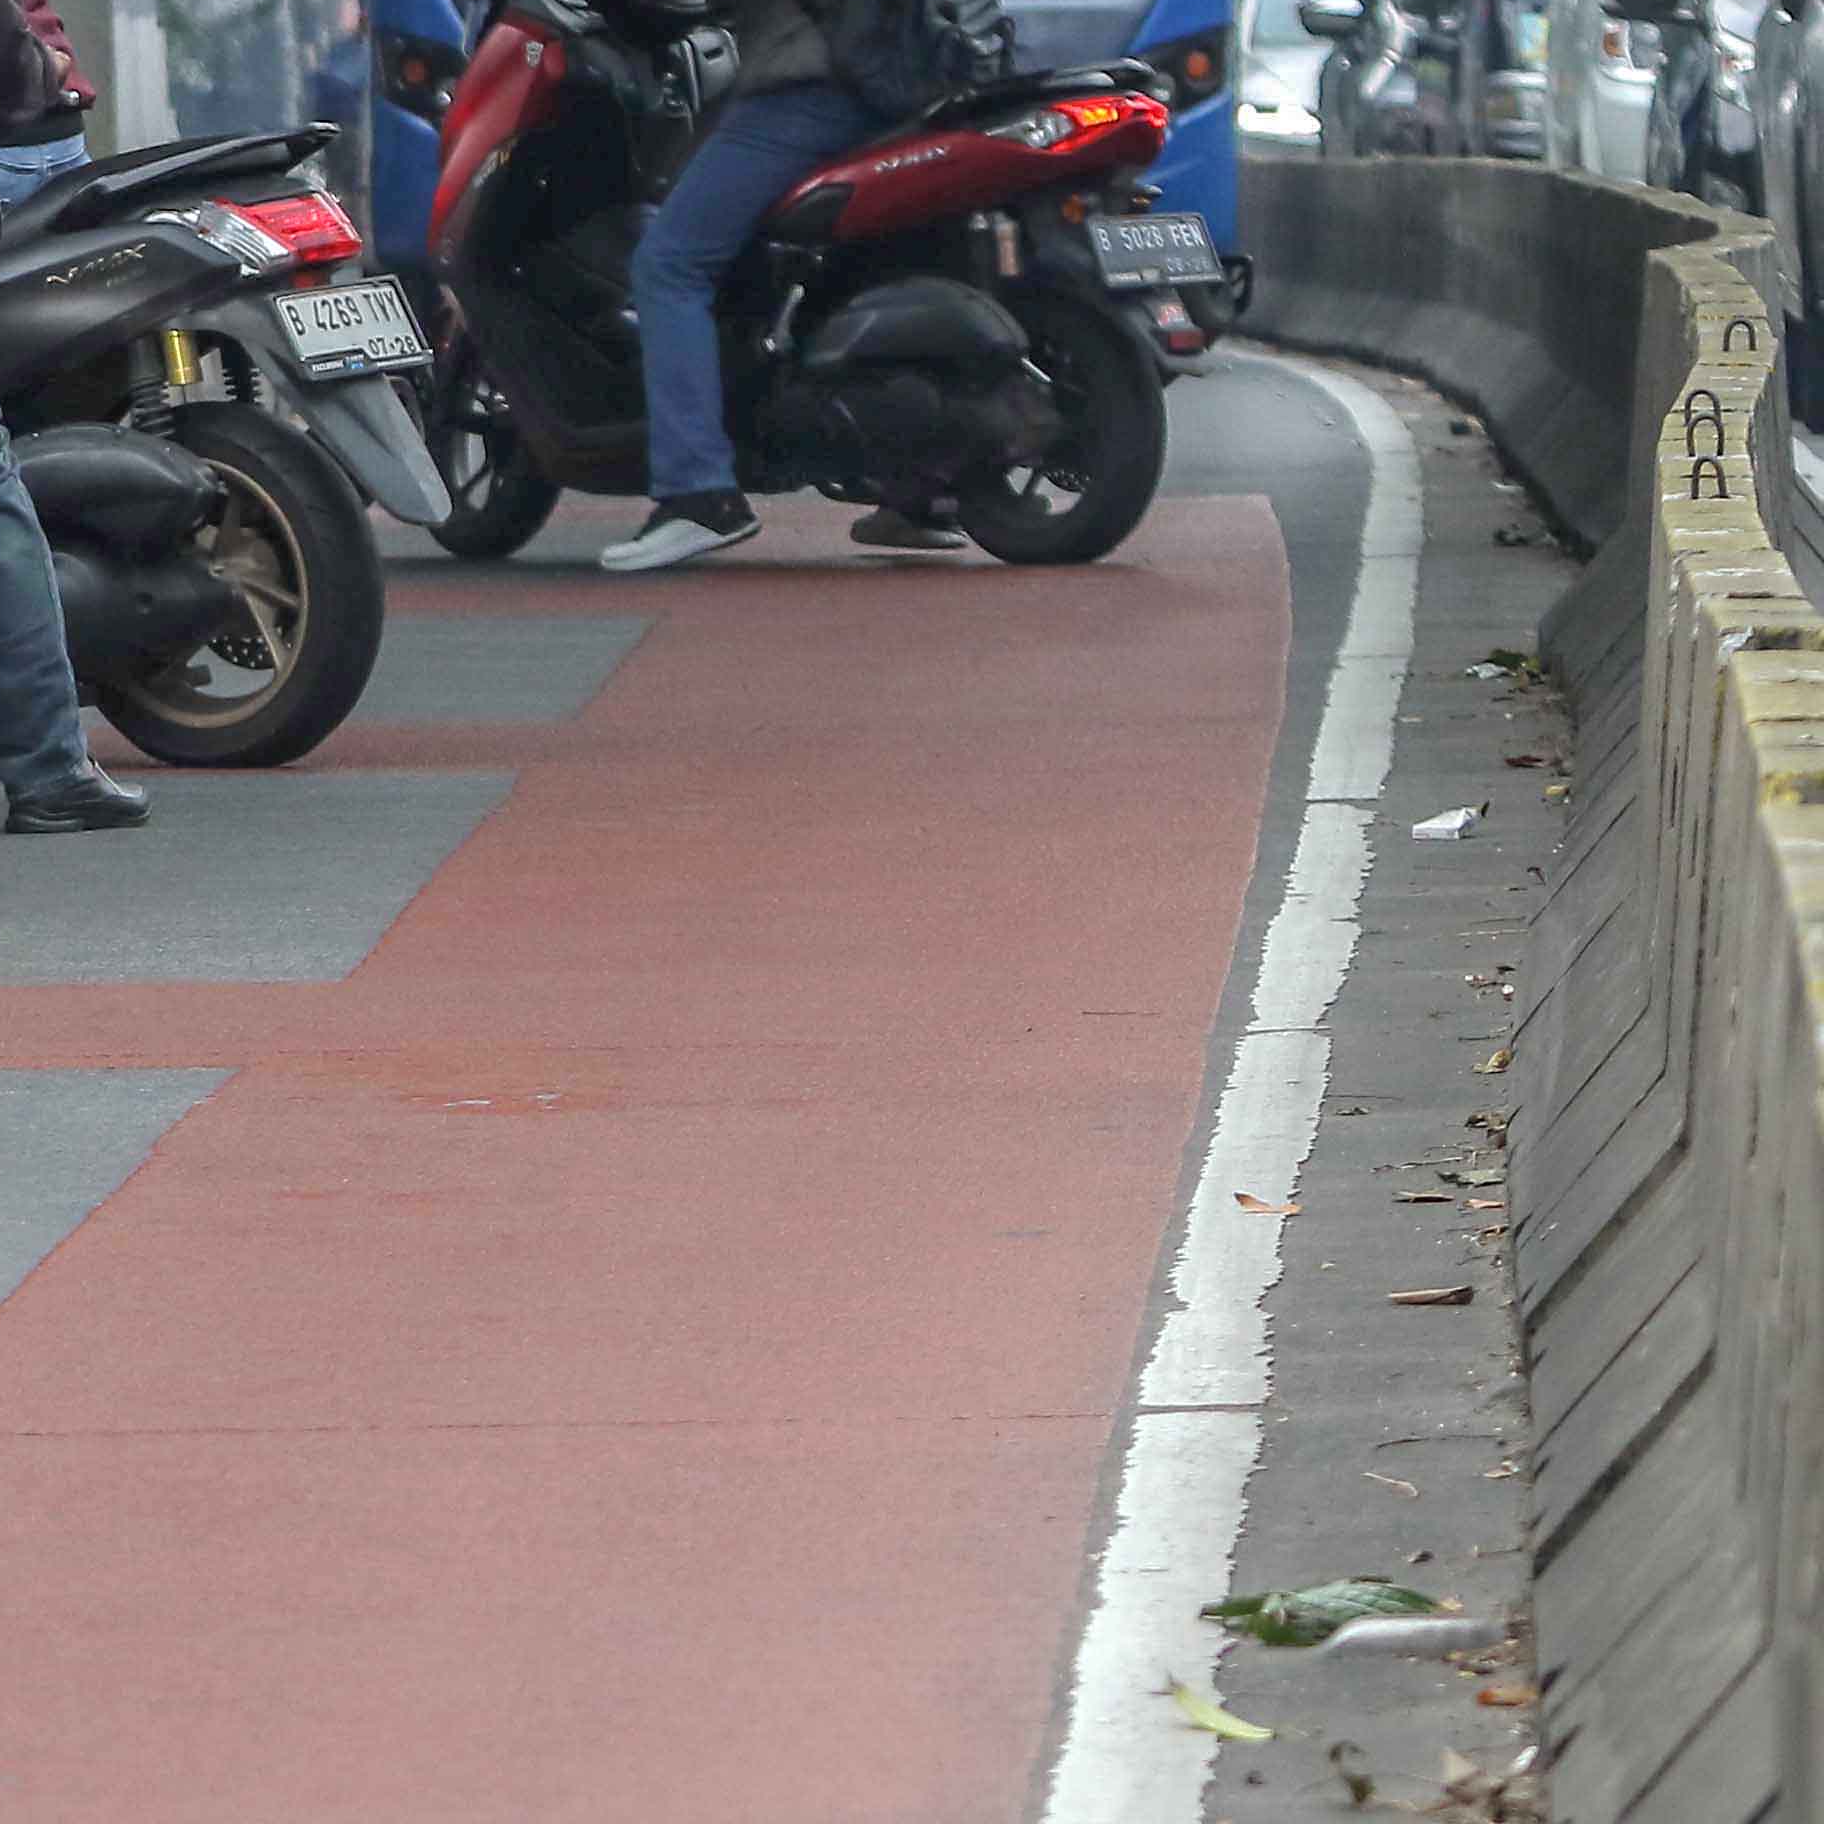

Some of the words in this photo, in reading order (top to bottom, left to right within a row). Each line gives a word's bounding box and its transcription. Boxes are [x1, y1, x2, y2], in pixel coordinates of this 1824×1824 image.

[1096, 227, 1112, 251] B
[286, 305, 306, 336] B
[313, 296, 363, 331] 4269
